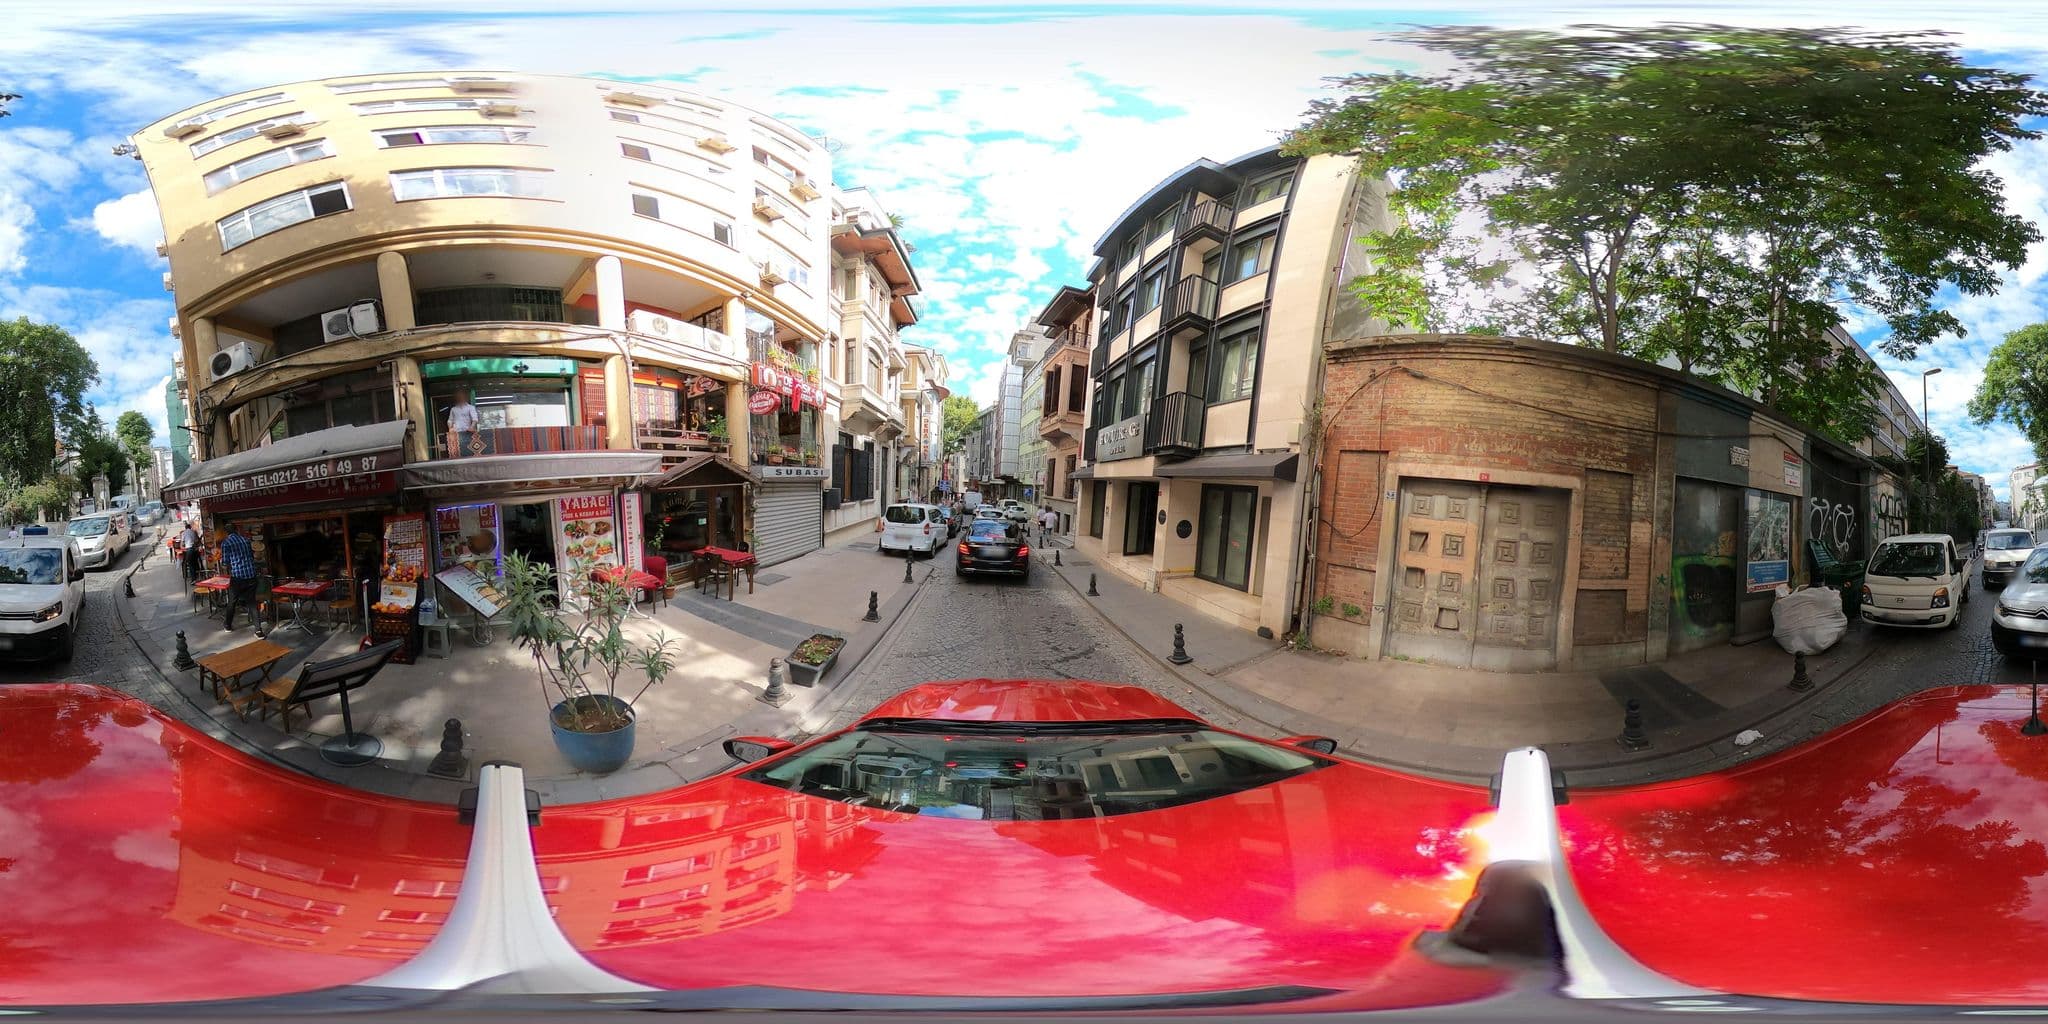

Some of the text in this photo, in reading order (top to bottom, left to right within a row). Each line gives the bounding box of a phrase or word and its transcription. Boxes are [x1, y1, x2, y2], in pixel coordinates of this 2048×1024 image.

[223, 477, 246, 491] BÜFE
[251, 469, 299, 488] TEL:0212
[306, 463, 328, 479] 516
[337, 459, 353, 474] 49
[361, 456, 378, 472] 87
